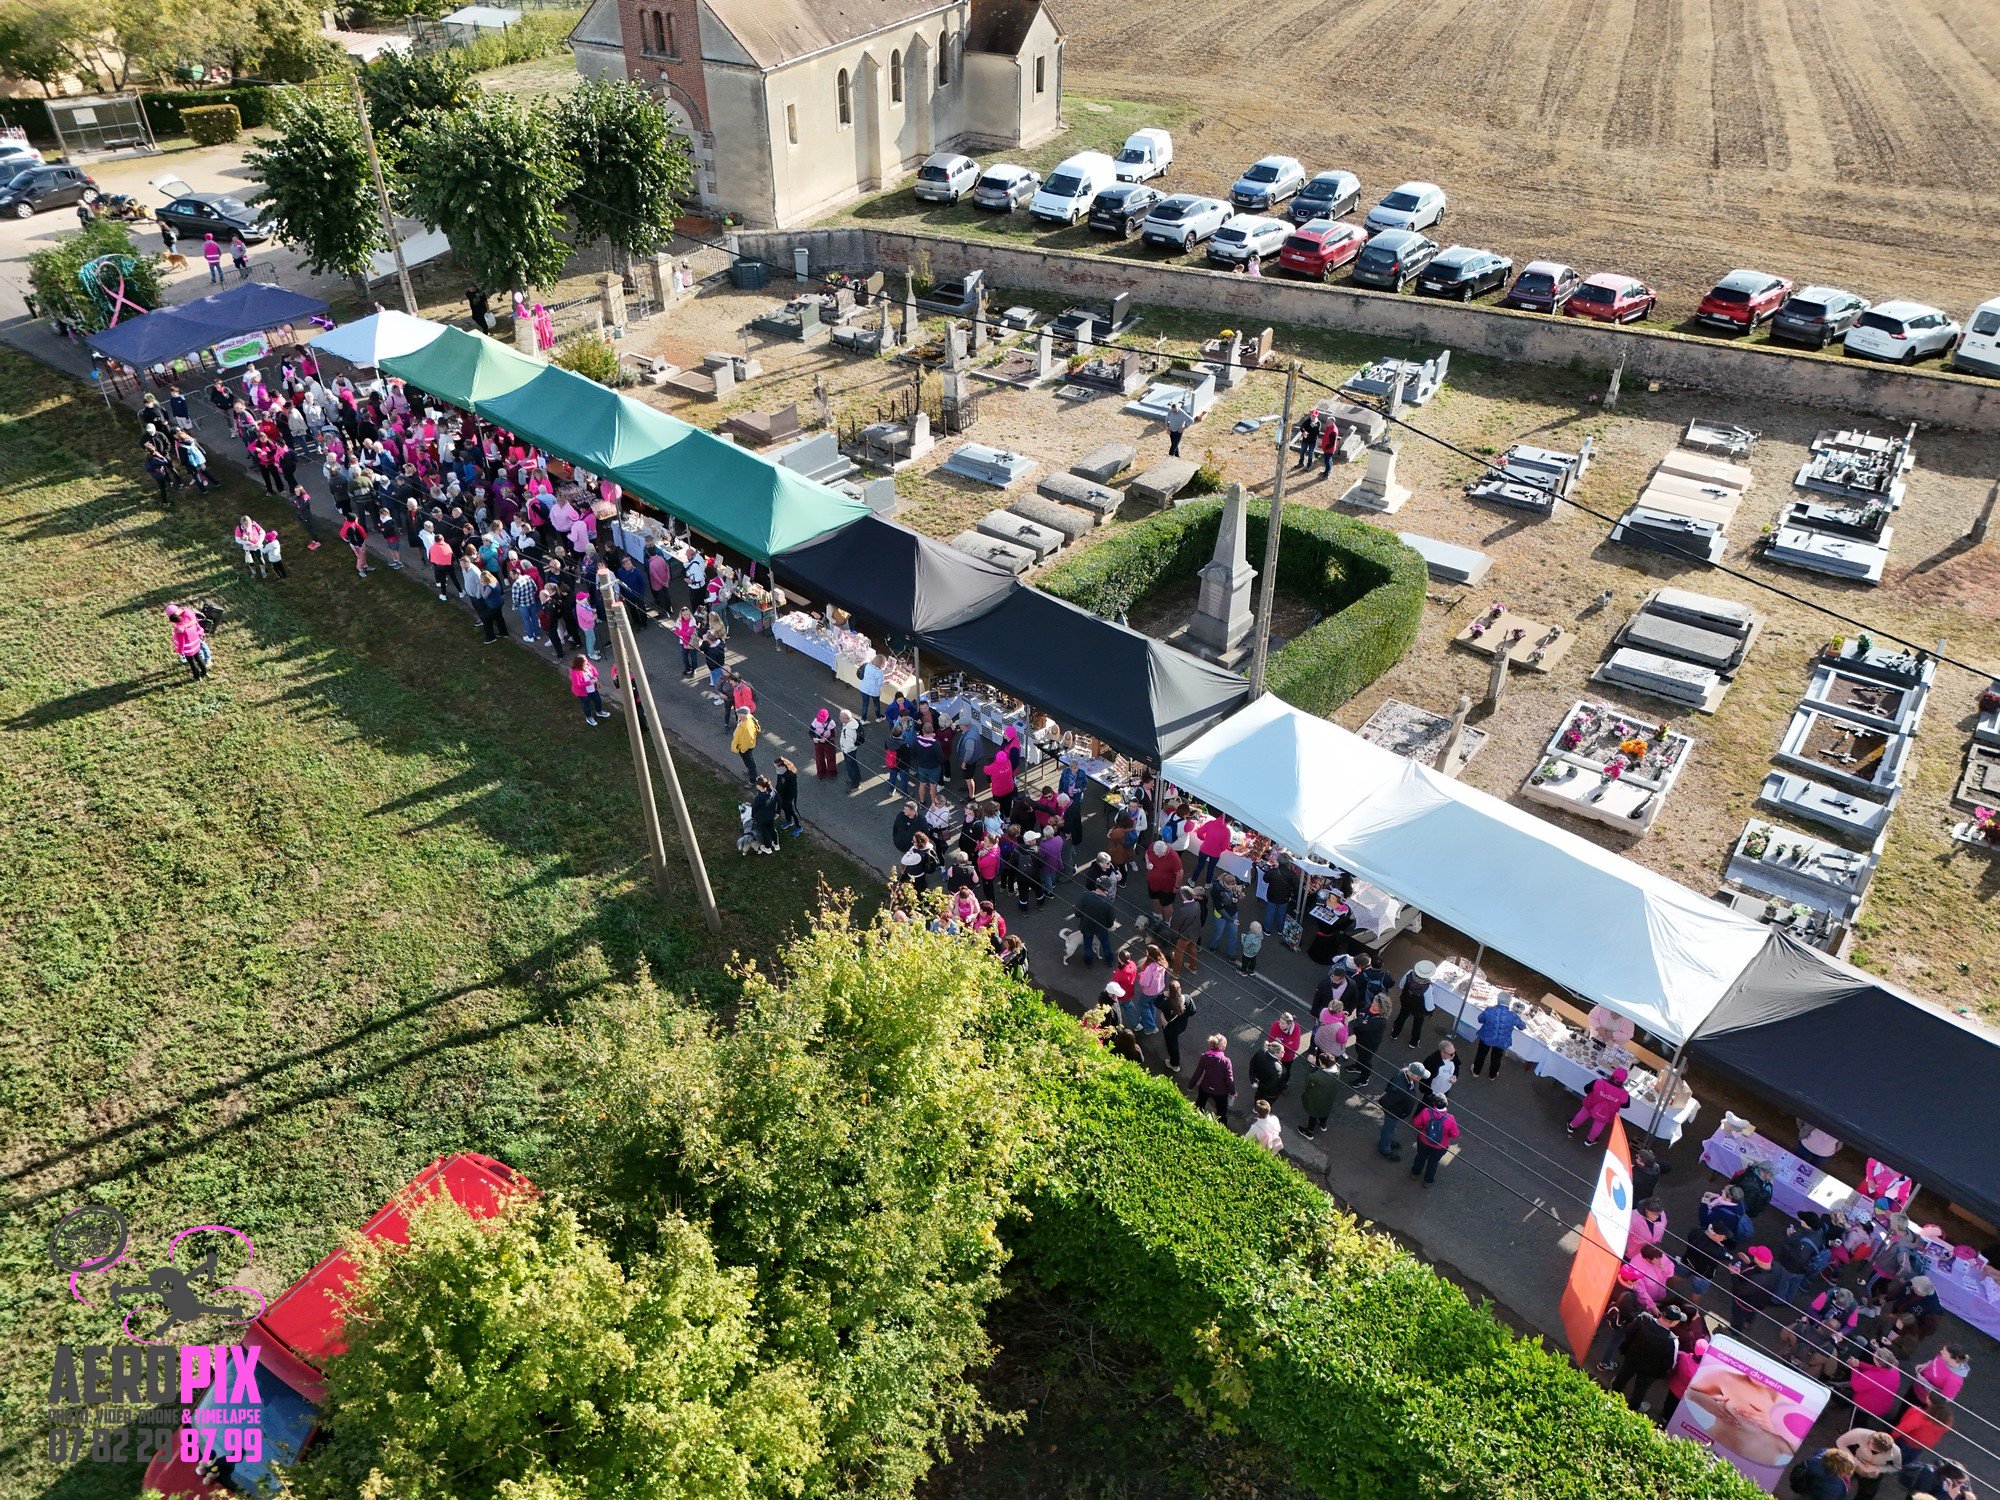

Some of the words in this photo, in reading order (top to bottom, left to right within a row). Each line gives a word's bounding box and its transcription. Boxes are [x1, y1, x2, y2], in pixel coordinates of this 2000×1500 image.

[1717, 1353, 1749, 1372] cancer
[1750, 1370, 1763, 1380] du
[1764, 1378, 1783, 1391] sein
